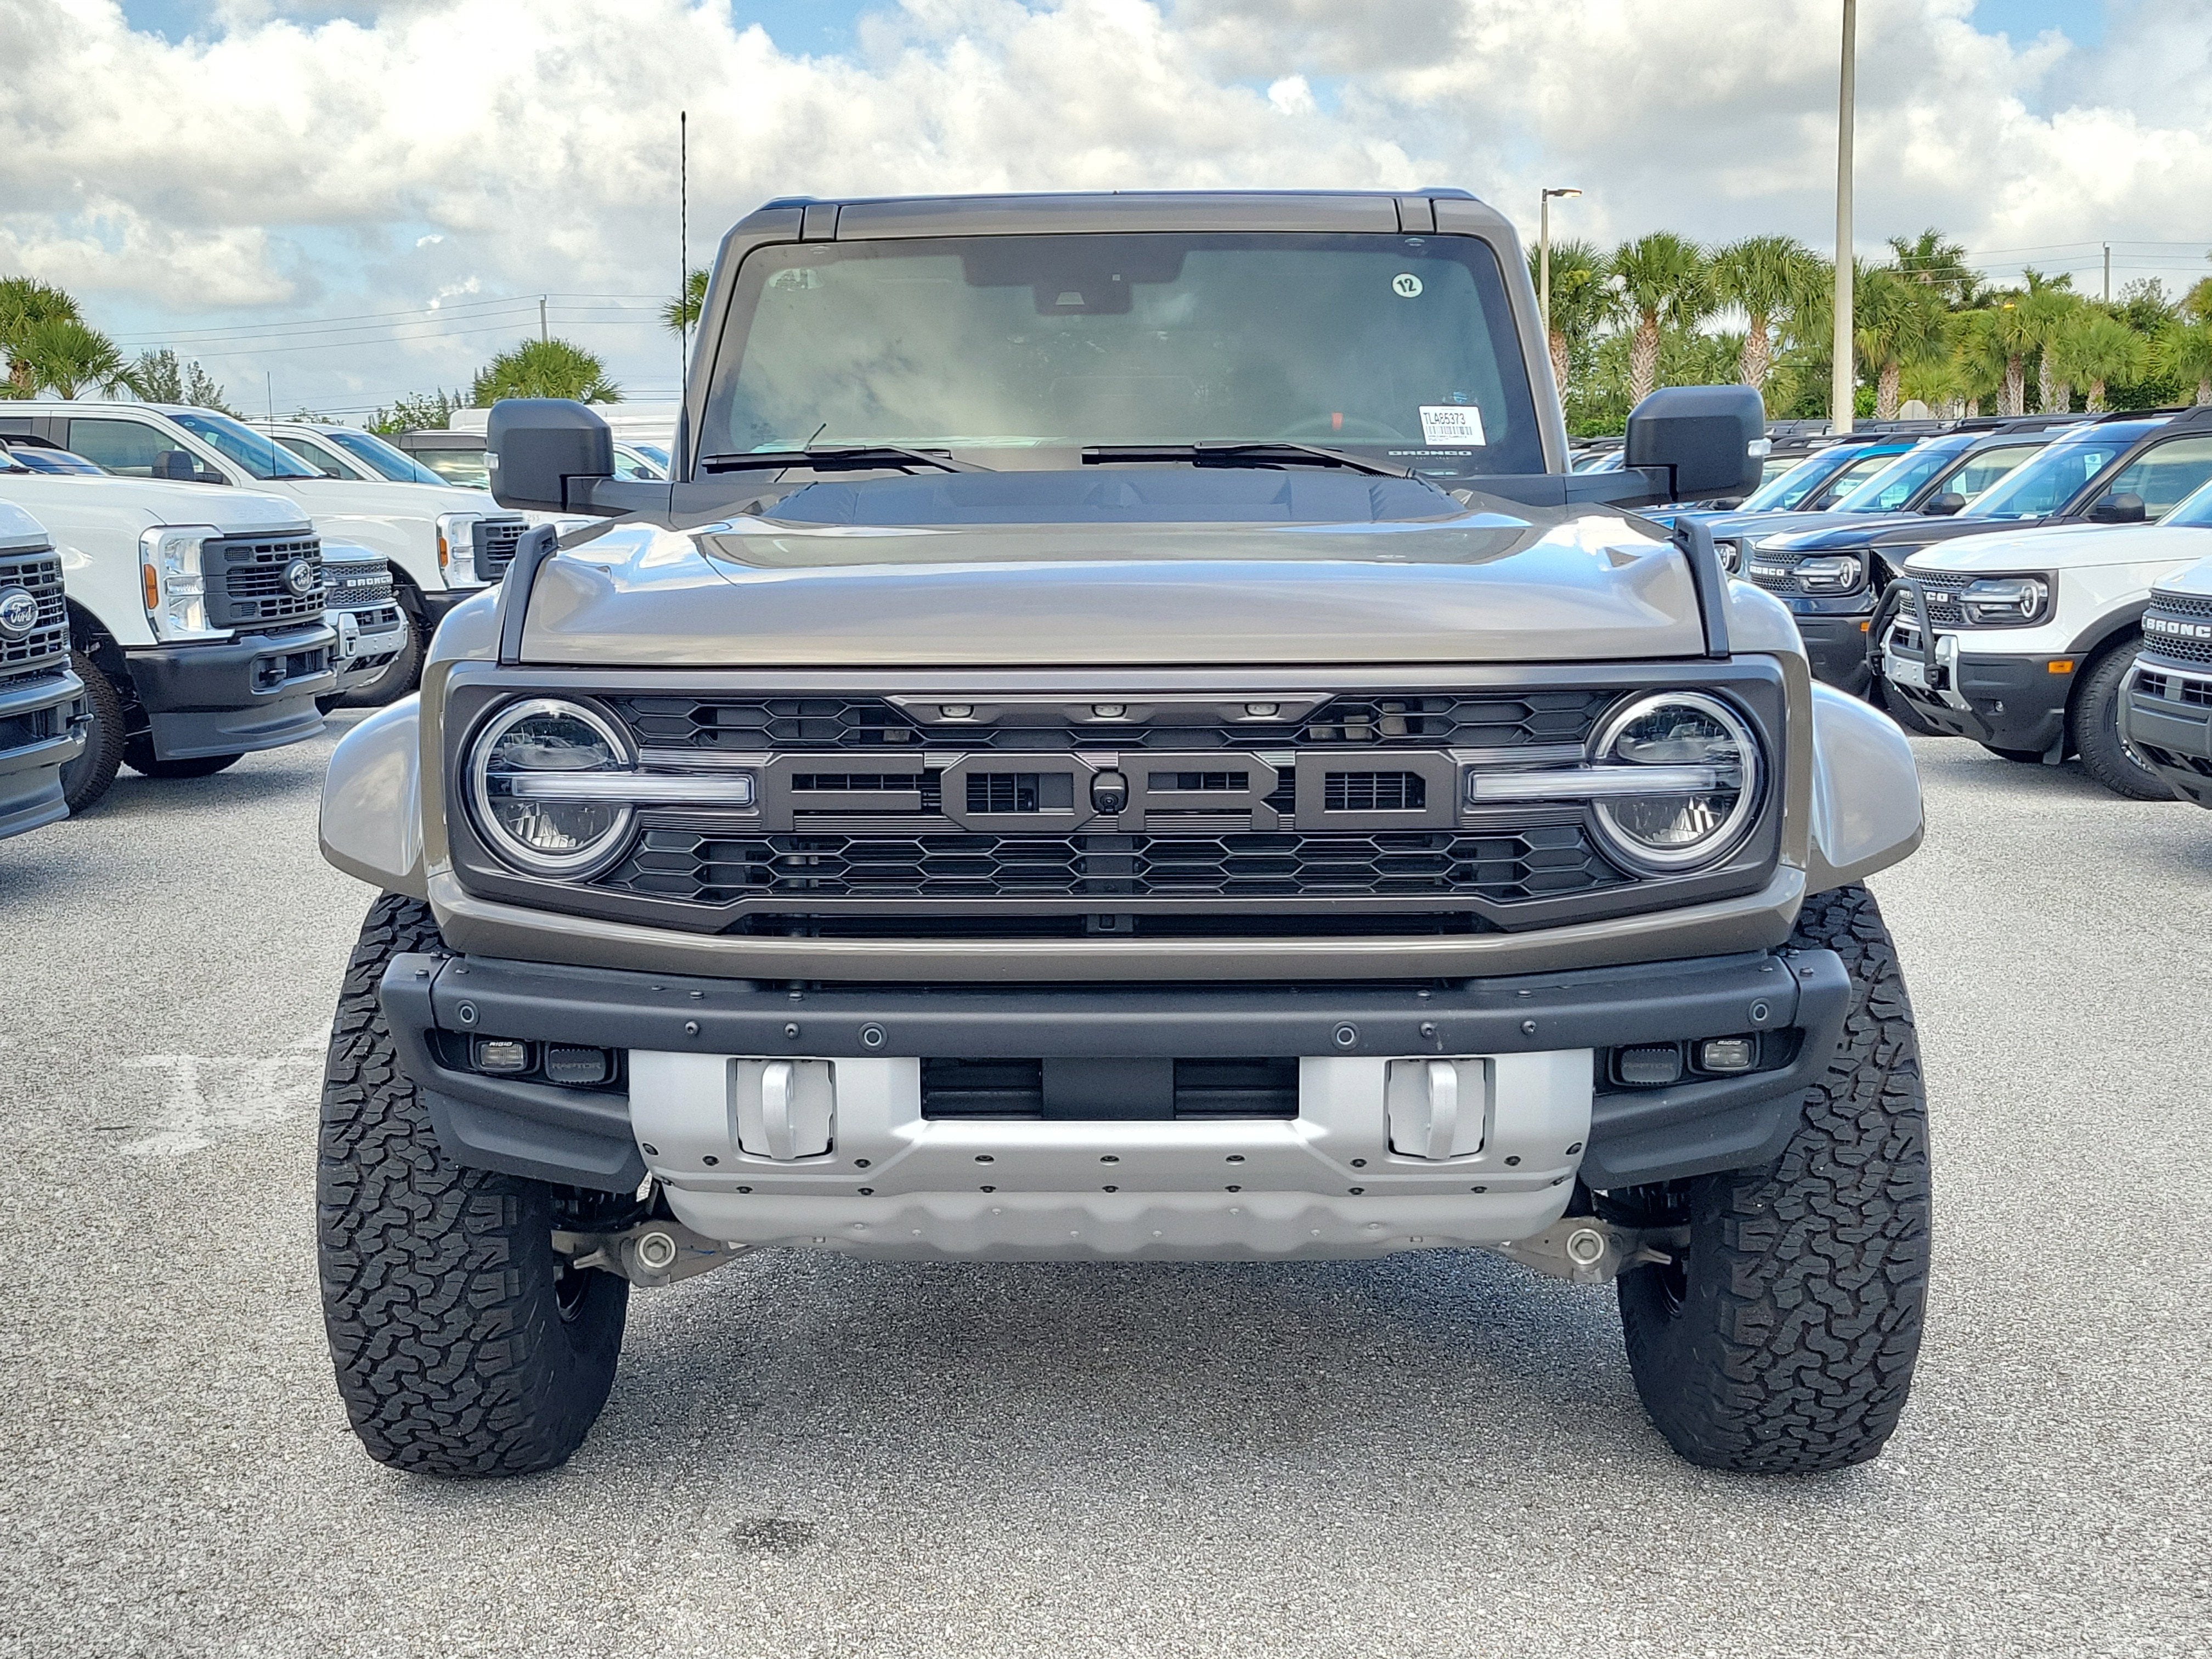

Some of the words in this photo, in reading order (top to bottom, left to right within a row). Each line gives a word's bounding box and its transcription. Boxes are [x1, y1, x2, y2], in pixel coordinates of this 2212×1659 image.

[1396, 278, 1417, 292] 12
[1423, 412, 1466, 425] TLA85373
[10, 602, 33, 623] Ford
[761, 752, 1456, 832] FORD
